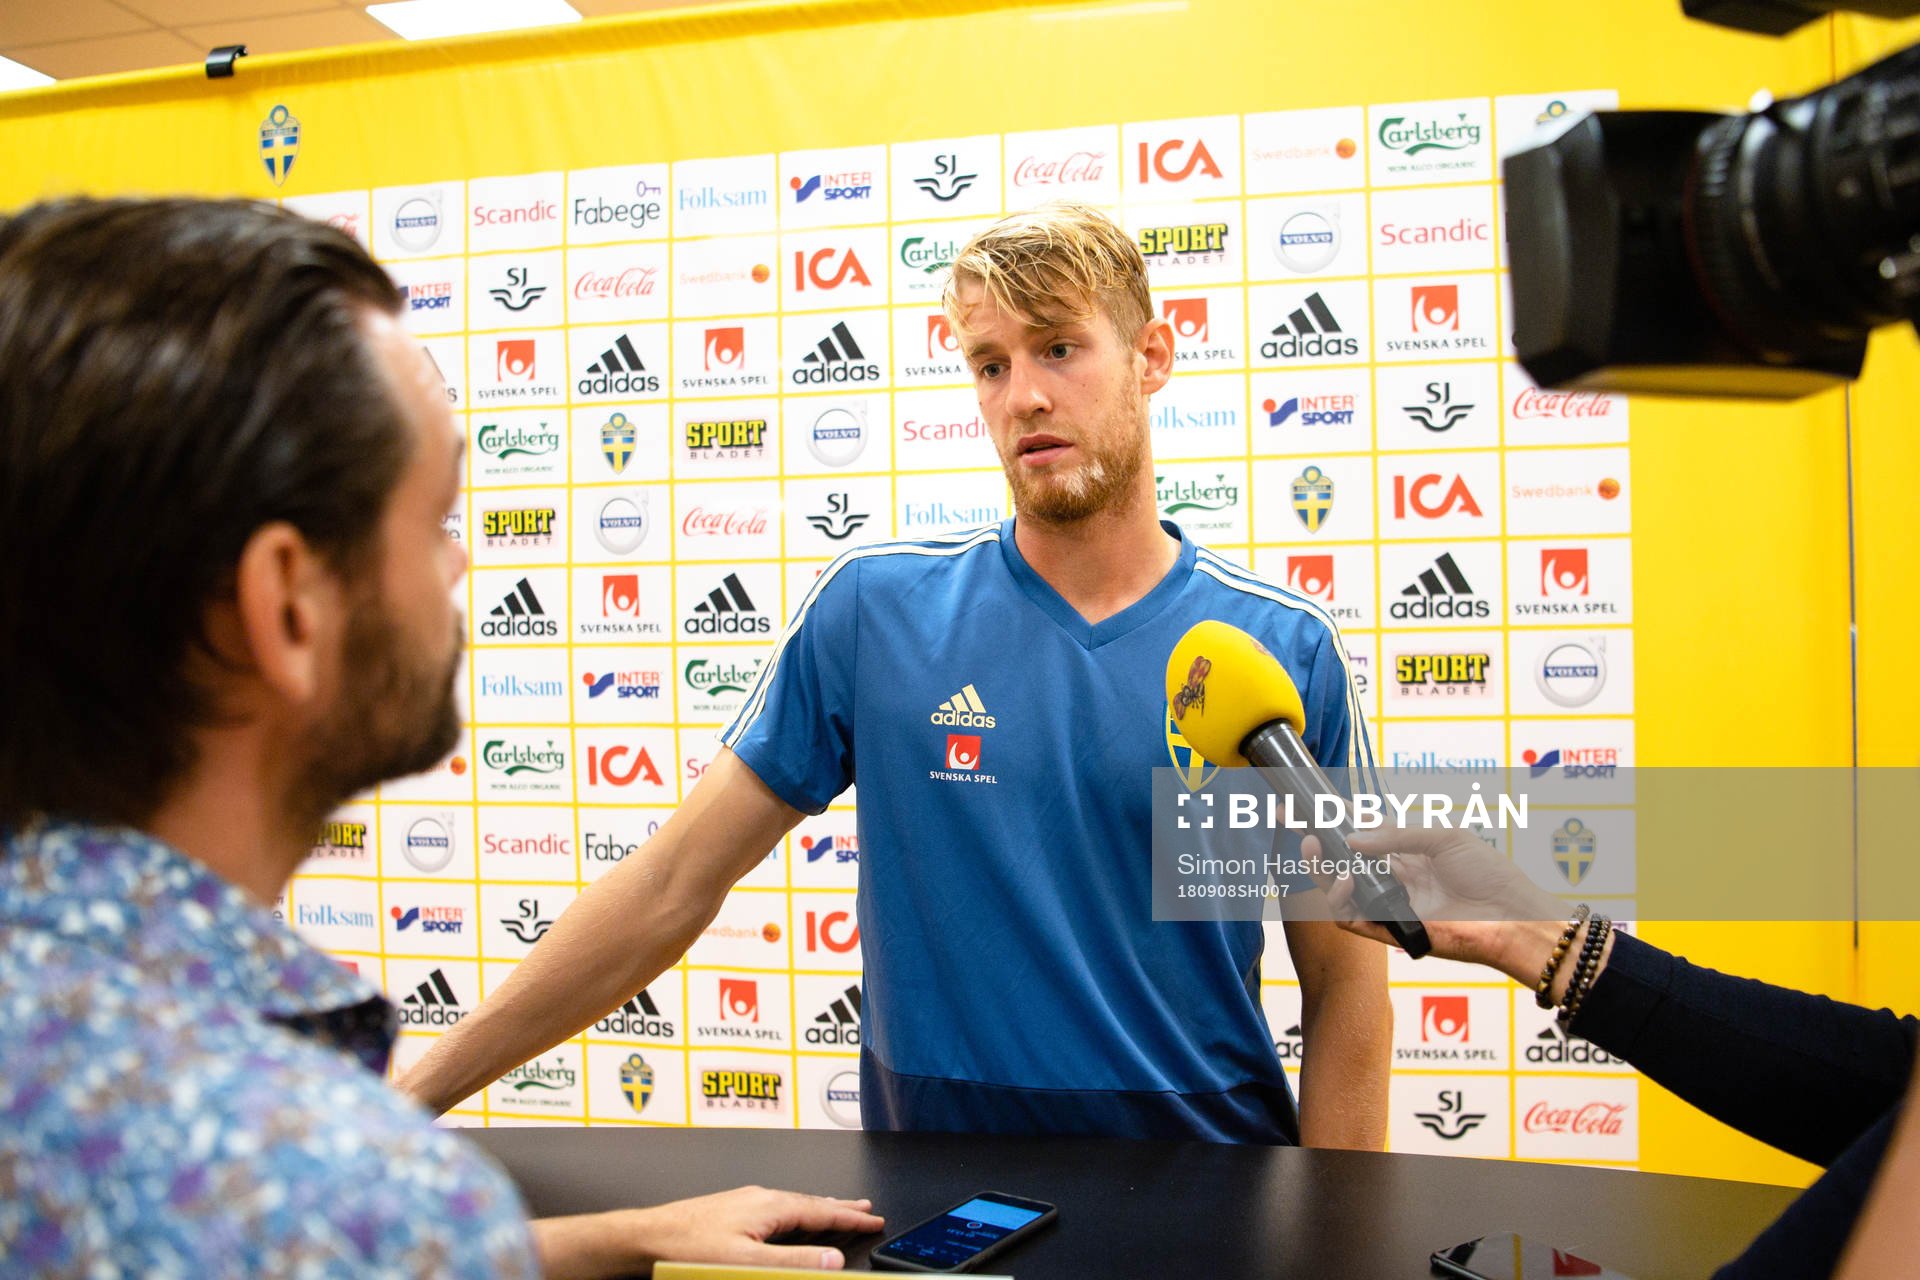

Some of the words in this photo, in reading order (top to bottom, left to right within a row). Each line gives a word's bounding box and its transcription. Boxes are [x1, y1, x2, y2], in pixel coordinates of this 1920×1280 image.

[1378, 117, 1481, 151] Carlsberg
[1138, 139, 1224, 184] ICA
[1253, 146, 1330, 161] Swedbank
[934, 155, 957, 176] SJ
[824, 172, 872, 186] INTER
[679, 187, 767, 211] Folksam
[824, 186, 872, 200] SPORT
[397, 214, 437, 227] VOLVO
[474, 200, 557, 226] Scandic
[575, 196, 661, 228] Fabege
[1138, 223, 1228, 257] SPORT
[1281, 233, 1332, 245] VOLVO
[1381, 220, 1488, 246] Scandic
[507, 267, 527, 287] SJ
[680, 271, 747, 285] Swedbank
[795, 248, 872, 291] ICA
[411, 282, 452, 298] INTER
[411, 296, 450, 310] SPORT
[1204, 350, 1235, 360] SPEL
[1261, 333, 1358, 359] adidas
[1387, 339, 1449, 352] SVENSKA
[1456, 338, 1487, 349] SPEL
[793, 362, 879, 384] adidas
[905, 365, 961, 377] SVENSKA
[578, 370, 659, 395] adidas
[682, 377, 736, 388] SVENSKA
[740, 375, 768, 386] SPEL
[478, 388, 526, 399] SVENSKA
[531, 386, 557, 396] SPEL
[1302, 395, 1354, 410] INTER
[1426, 382, 1450, 404] SJ
[1149, 406, 1236, 429] olksam
[1302, 411, 1354, 426] SPORT
[686, 420, 766, 449] SPORT
[815, 428, 859, 439] VOLVO
[903, 417, 988, 441] Scandi
[478, 425, 559, 455] Carlsberg
[690, 449, 764, 460] BLADET
[1394, 473, 1483, 519] ICA
[1512, 485, 1592, 498] Swedbank
[827, 493, 848, 515] SJ
[483, 508, 555, 538] SPORT
[602, 518, 640, 528] VOLVO
[905, 503, 999, 526] Folksam
[487, 537, 552, 547] BLADET
[1330, 608, 1361, 619] SPEL
[1390, 596, 1490, 619] adidas
[1516, 604, 1578, 615] SVENSKA
[1585, 603, 1617, 613] SPEL
[481, 615, 557, 636] adidas
[581, 624, 633, 633] SVENSKA
[637, 623, 661, 632] SPEL
[684, 612, 771, 634] adidas
[617, 672, 660, 685] INTER
[1396, 653, 1489, 685] SPORT
[1546, 666, 1597, 678] VOLVO
[481, 675, 563, 696] Folksam
[617, 686, 659, 699] SPORT
[1401, 686, 1486, 697] BLADET
[930, 709, 996, 729] adidas
[483, 740, 564, 769] Carlsberg
[1393, 752, 1497, 777] Folksam
[1563, 749, 1617, 763] INTER
[588, 746, 664, 786] ICA
[1564, 765, 1617, 779] SPORT
[929, 771, 971, 782] SVENSKA
[974, 773, 997, 784] SPEL
[316, 822, 366, 849] PORT
[410, 837, 448, 847] VOLVO
[484, 833, 570, 855] Scandic
[836, 836, 858, 848] INT
[586, 833, 638, 861] Fabe
[299, 904, 374, 929] Folksam
[421, 906, 463, 919] INTER
[519, 900, 539, 920] SJ
[422, 920, 463, 934] SPORT
[806, 911, 859, 953] IC
[595, 1015, 674, 1037] adidas
[698, 1026, 751, 1039] SVENSKA
[755, 1029, 782, 1040] SPEL
[805, 1024, 860, 1045] adid
[1397, 1049, 1458, 1059] SVENSKA
[1464, 1050, 1496, 1060] SPEL
[499, 1057, 575, 1088] arlsberg
[703, 1071, 781, 1099] SPORT
[707, 1099, 779, 1109] BLADET
[1438, 1091, 1462, 1112] SJ
